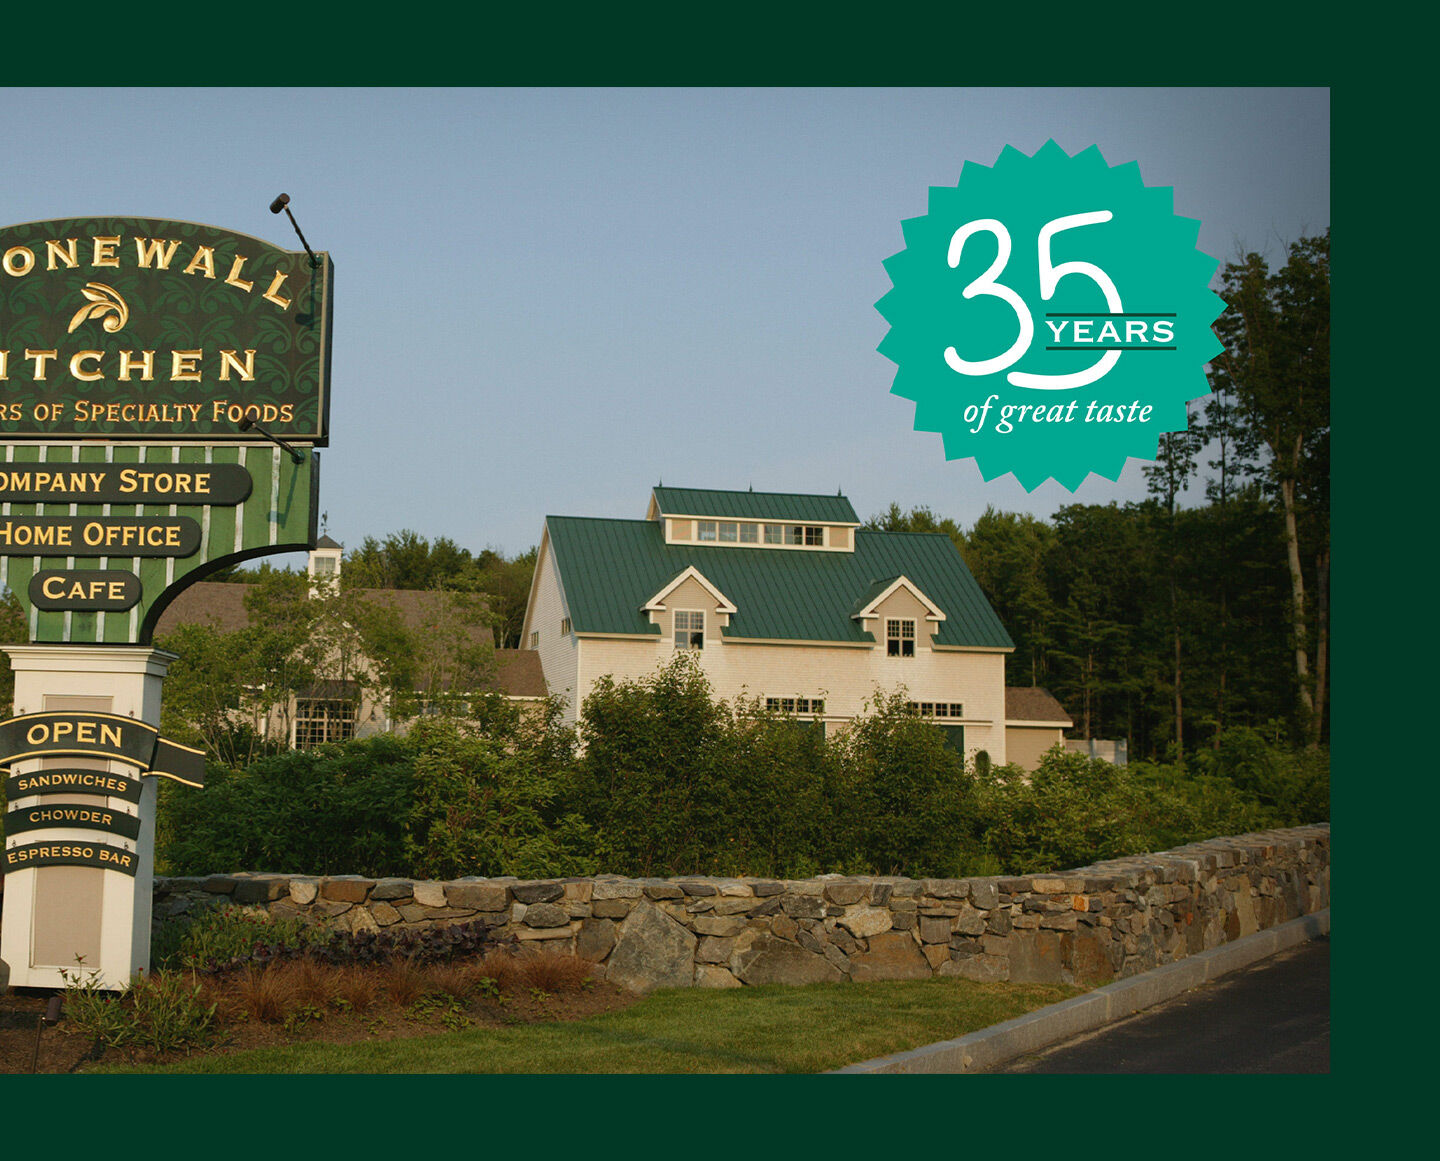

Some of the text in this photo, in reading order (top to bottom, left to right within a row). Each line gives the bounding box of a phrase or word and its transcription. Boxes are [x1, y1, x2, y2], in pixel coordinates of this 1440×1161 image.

[33, 400, 63, 422] OF
[74, 400, 201, 423] SPECIALTY
[212, 400, 294, 423] FOODS
[118, 468, 211, 494] STORE
[83, 522, 181, 547] OFFICE
[42, 577, 125, 600] CAFE
[26, 721, 123, 749] OPEN
[18, 773, 127, 792] SANDWICHES
[29, 809, 113, 826] CHOWDER
[7, 846, 132, 868] ESPRESSO BAR
